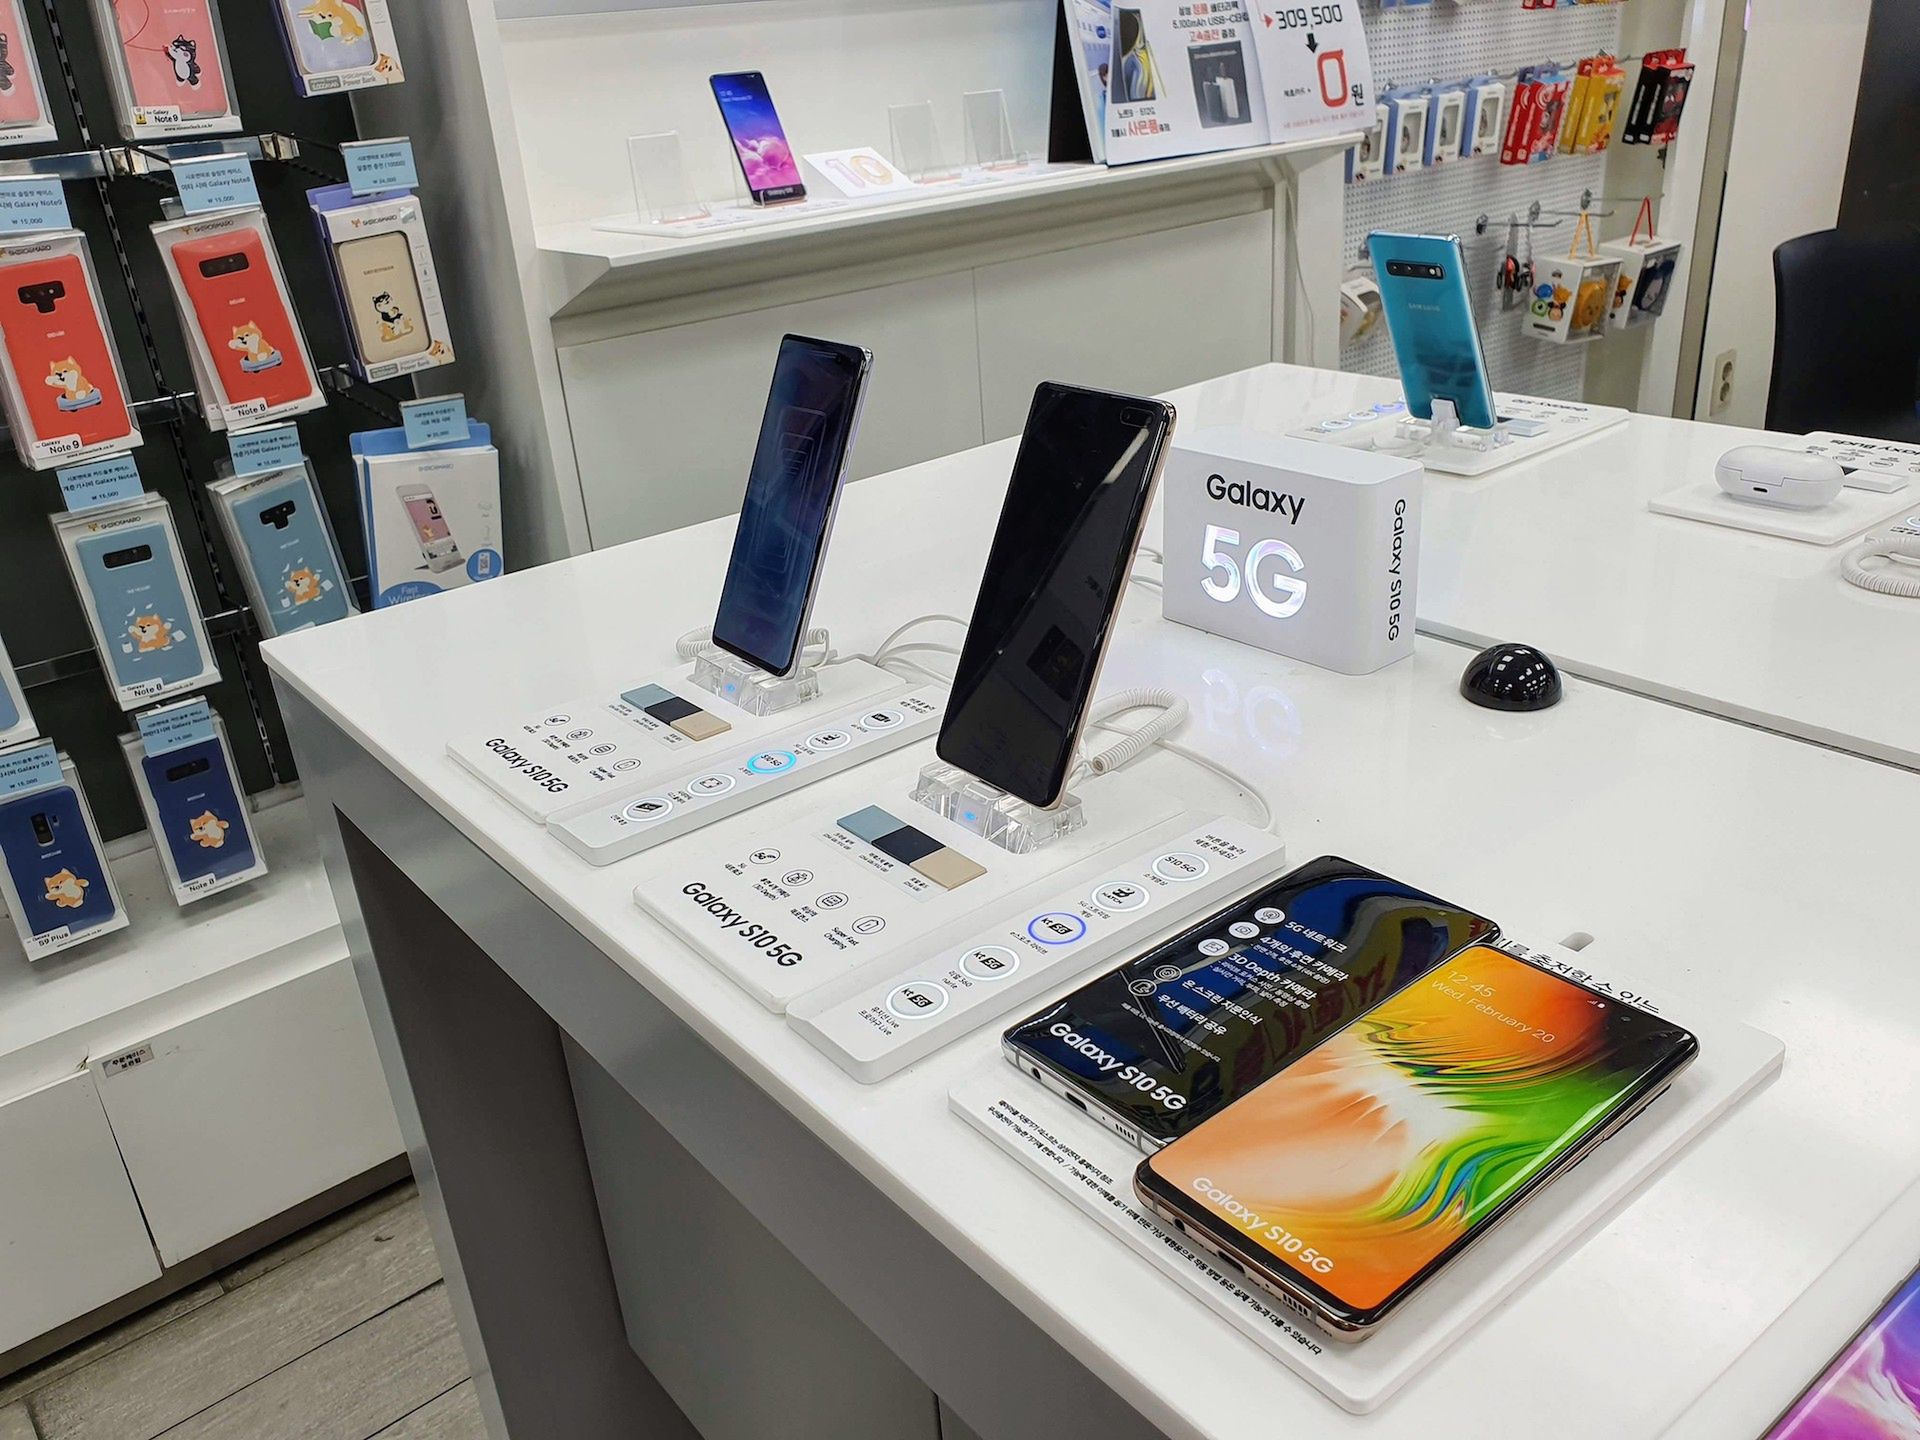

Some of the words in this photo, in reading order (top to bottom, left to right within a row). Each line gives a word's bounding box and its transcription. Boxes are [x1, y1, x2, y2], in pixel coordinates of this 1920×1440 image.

[1275, 4, 1343, 30] 309,500
[1317, 49, 1348, 108] 0
[1351, 83, 1364, 107] 원
[154, 115, 172, 124] Note
[1128, 119, 1159, 137] 사은품
[20, 217, 43, 225] 15,000
[238, 407, 258, 417] Note
[259, 403, 266, 412] 8
[49, 445, 72, 454] Note
[72, 440, 80, 449] 9
[1829, 439, 1876, 451] Buds
[95, 477, 117, 485] Galaxy
[1206, 473, 1305, 525] Galaxy
[1389, 498, 1406, 576] Galaxy
[1200, 524, 1307, 619] 5G
[1389, 578, 1402, 611] S10
[1388, 613, 1400, 642] 5G
[134, 687, 155, 697] Note
[485, 738, 532, 769] Galaxy
[522, 765, 553, 781] S10
[540, 777, 569, 793] 5G
[760, 754, 774, 762] S10
[17, 764, 40, 773] Galaxy
[1164, 856, 1183, 866] S10
[1180, 864, 1197, 872] 5G
[189, 882, 208, 892] Note
[1102, 892, 1123, 904] HATCH
[682, 882, 749, 929] Galaxy
[739, 924, 778, 948] S10
[766, 944, 803, 966] 5G
[1048, 923, 1073, 935] 5G
[51, 932, 69, 944] Plus
[824, 933, 847, 950] Charging
[831, 927, 847, 937] Super
[846, 936, 859, 946] Fast
[1285, 921, 1304, 932] 5G
[1302, 928, 1347, 953] 네트워크
[973, 952, 986, 960] kt
[979, 957, 1005, 970] 5G
[1260, 937, 1293, 954] 4개의
[1289, 950, 1315, 965] 후면
[1312, 961, 1349, 981] 카메라
[958, 977, 973, 987] 360
[1228, 950, 1248, 964] 3D
[1245, 962, 1281, 986] Depth
[1280, 978, 1317, 1000] 카메라
[901, 988, 914, 997] kt
[1447, 970, 1496, 999] 12:45
[907, 994, 933, 1008] 5G
[1177, 1004, 1208, 1025] 배터리
[1203, 1020, 1227, 1035] 공유
[1221, 1000, 1263, 1025] 지문인식
[1431, 980, 1463, 1003] Wed,
[1466, 998, 1532, 1034] February
[1532, 1028, 1555, 1044] 20
[886, 1017, 899, 1028] Live
[1050, 1023, 1123, 1070] Galaxy
[1117, 1066, 1157, 1091] S10
[1150, 1086, 1187, 1109] 5G
[1037, 1128, 1058, 1146] 리스트는
[1057, 1144, 1081, 1161] 삼성전자
[1078, 1159, 1103, 1177] 홈페이지
[1099, 1174, 1114, 1185] 참조
[1193, 1177, 1268, 1230] Galaxy
[1264, 1225, 1303, 1253] S10
[1298, 1248, 1334, 1273] 5G
[1011, 1124, 1029, 1137] 가능한
[1026, 1135, 1044, 1149] 기기에
[1041, 1146, 1065, 1164] 한합니다
[1069, 1166, 1088, 1181] 기능에
[1085, 1178, 1099, 1189] 대한
[1097, 1187, 1116, 1202] 이해를
[1113, 1200, 1128, 1211] 돕기
[1126, 1209, 1141, 1220] 위해
[1137, 1217, 1153, 1230] 만든
[1150, 1226, 1166, 1238] 가상
[1163, 1236, 1195, 1261] 체험용으로
[1194, 1258, 1209, 1271] 작동
[1206, 1268, 1223, 1281] 방법
[1219, 1278, 1236, 1291] 등은
[1233, 1289, 1250, 1302] 실제
[1248, 1298, 1271, 1317] 기능과
[1268, 1314, 1285, 1328] 다를
[1290, 1331, 1322, 1355] 있습니다
